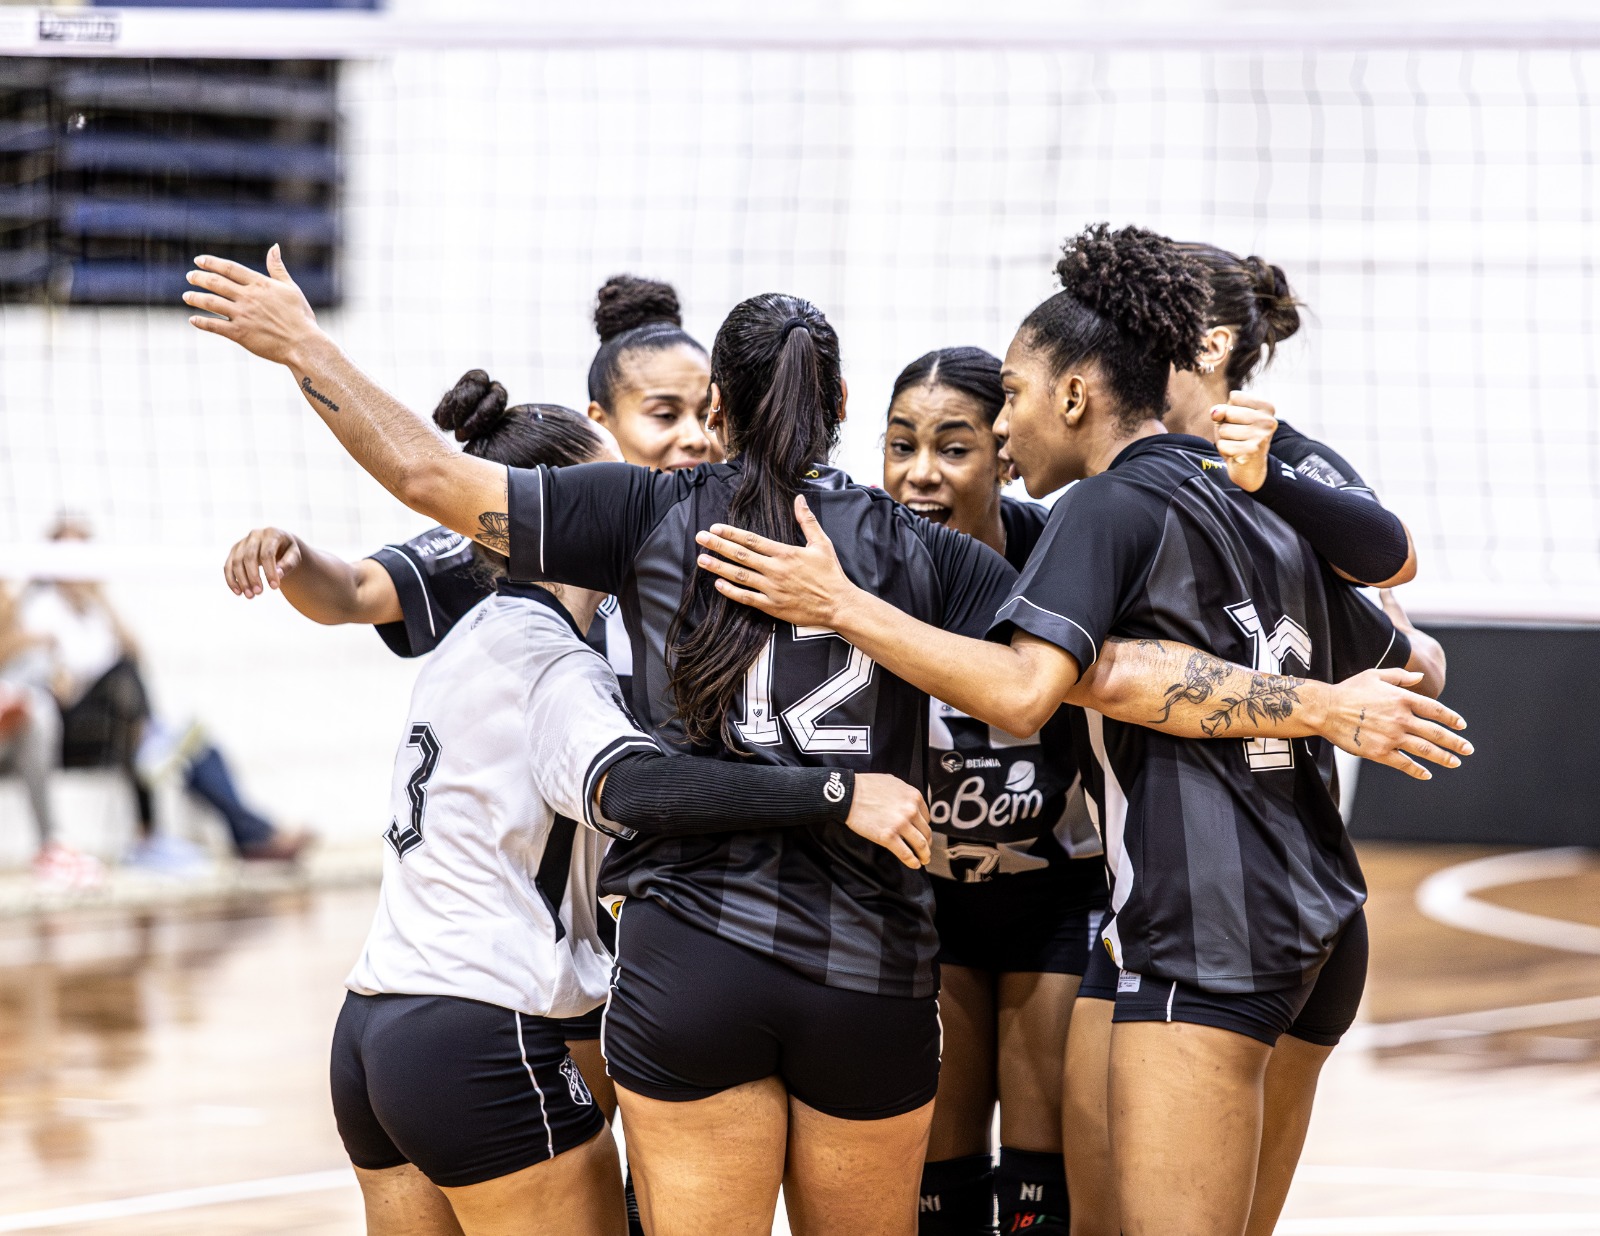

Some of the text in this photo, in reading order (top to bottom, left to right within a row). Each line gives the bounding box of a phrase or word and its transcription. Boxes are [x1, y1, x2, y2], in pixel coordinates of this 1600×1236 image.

[733, 622, 877, 755] 12
[382, 721, 443, 864] 3
[929, 775, 1044, 830] oBem
